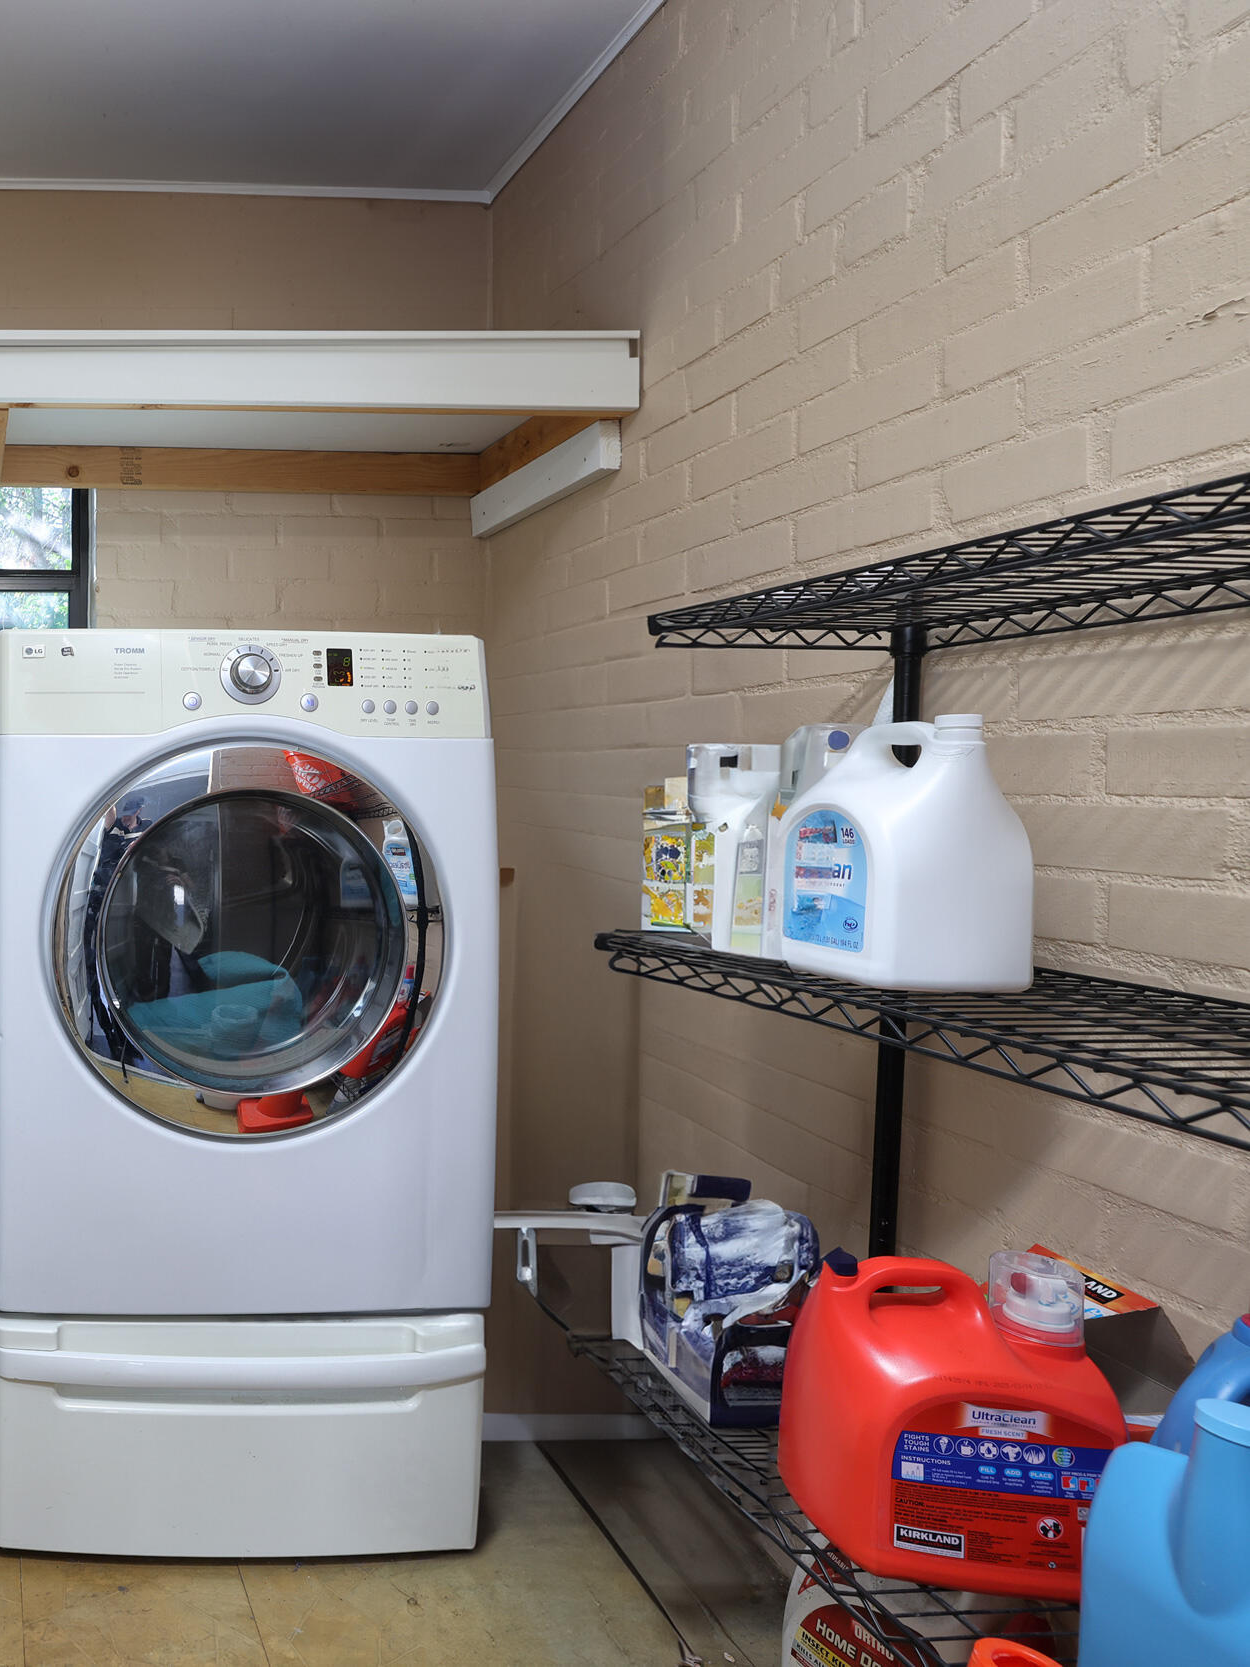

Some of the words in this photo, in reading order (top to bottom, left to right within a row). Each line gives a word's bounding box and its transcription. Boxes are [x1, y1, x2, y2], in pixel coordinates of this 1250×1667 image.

[113, 647, 145, 655] TROMM
[840, 827, 854, 839] 146
[972, 1410, 1036, 1425] UltraClean
[904, 1433, 930, 1442] FIGHTS
[981, 1428, 1003, 1436] FRESH
[1003, 1430, 1025, 1438] SCENT
[904, 1439, 930, 1447] TOUGH
[904, 1445, 930, 1453] STAINS
[901, 1455, 951, 1466] INSTRUCTIONS
[1005, 1469, 1022, 1477] ADD
[1030, 1471, 1053, 1480] PLACE
[900, 1528, 960, 1545] KIRKLAND
[816, 1618, 857, 1660] HOME
[801, 1631, 830, 1658] INSECT
